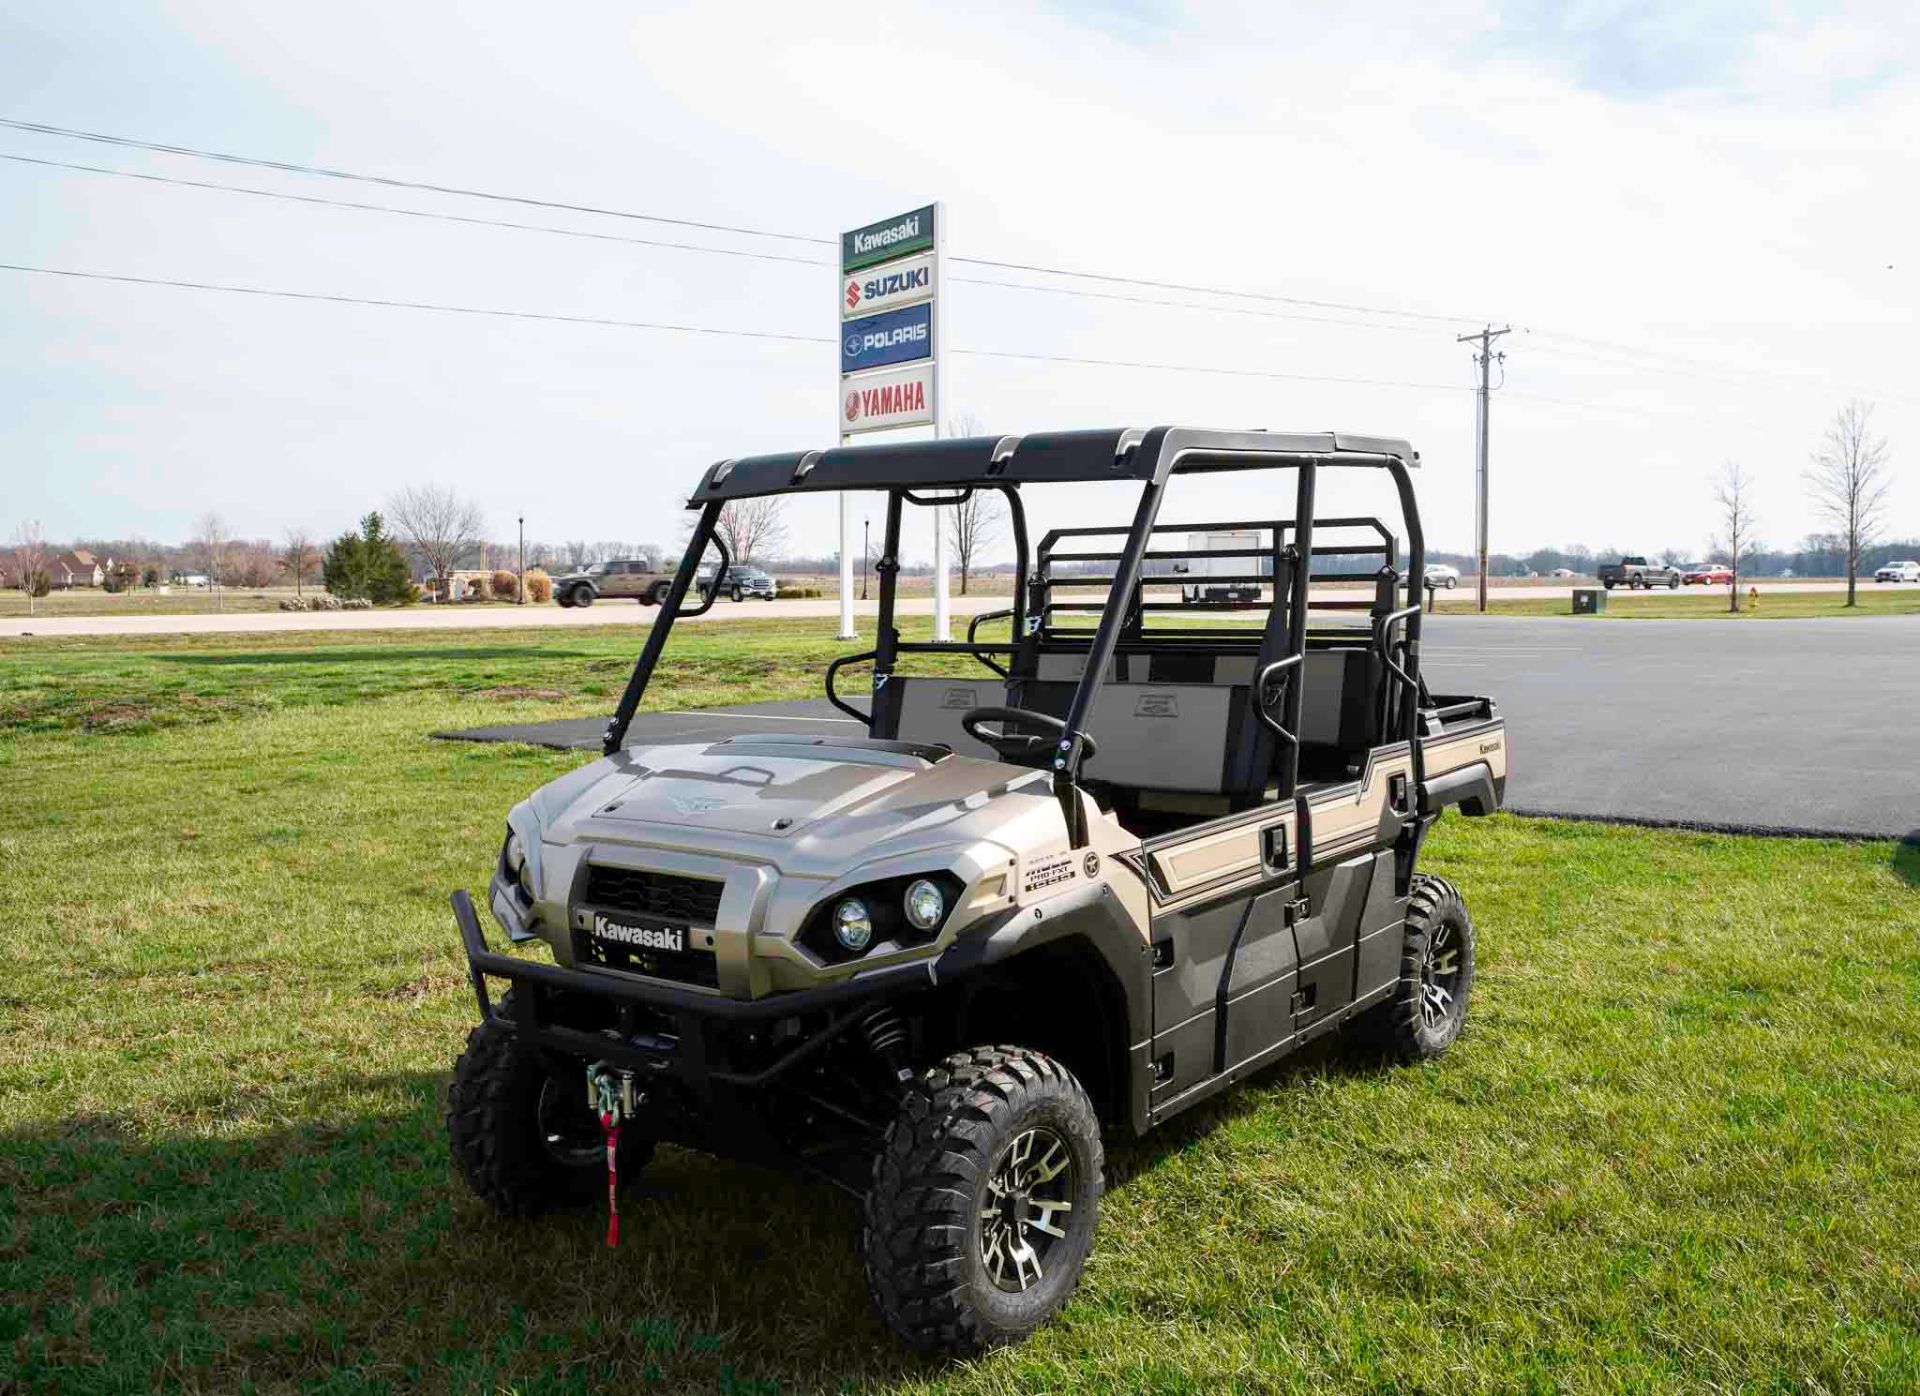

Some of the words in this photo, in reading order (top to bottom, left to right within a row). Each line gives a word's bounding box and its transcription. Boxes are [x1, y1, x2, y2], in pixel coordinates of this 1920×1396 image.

[855, 215, 919, 254] Kawasaki
[864, 267, 928, 300] SUZUKI
[864, 323, 927, 350] POLARIS
[862, 381, 924, 417] YAMAHA
[595, 915, 682, 951] Kawasaki
